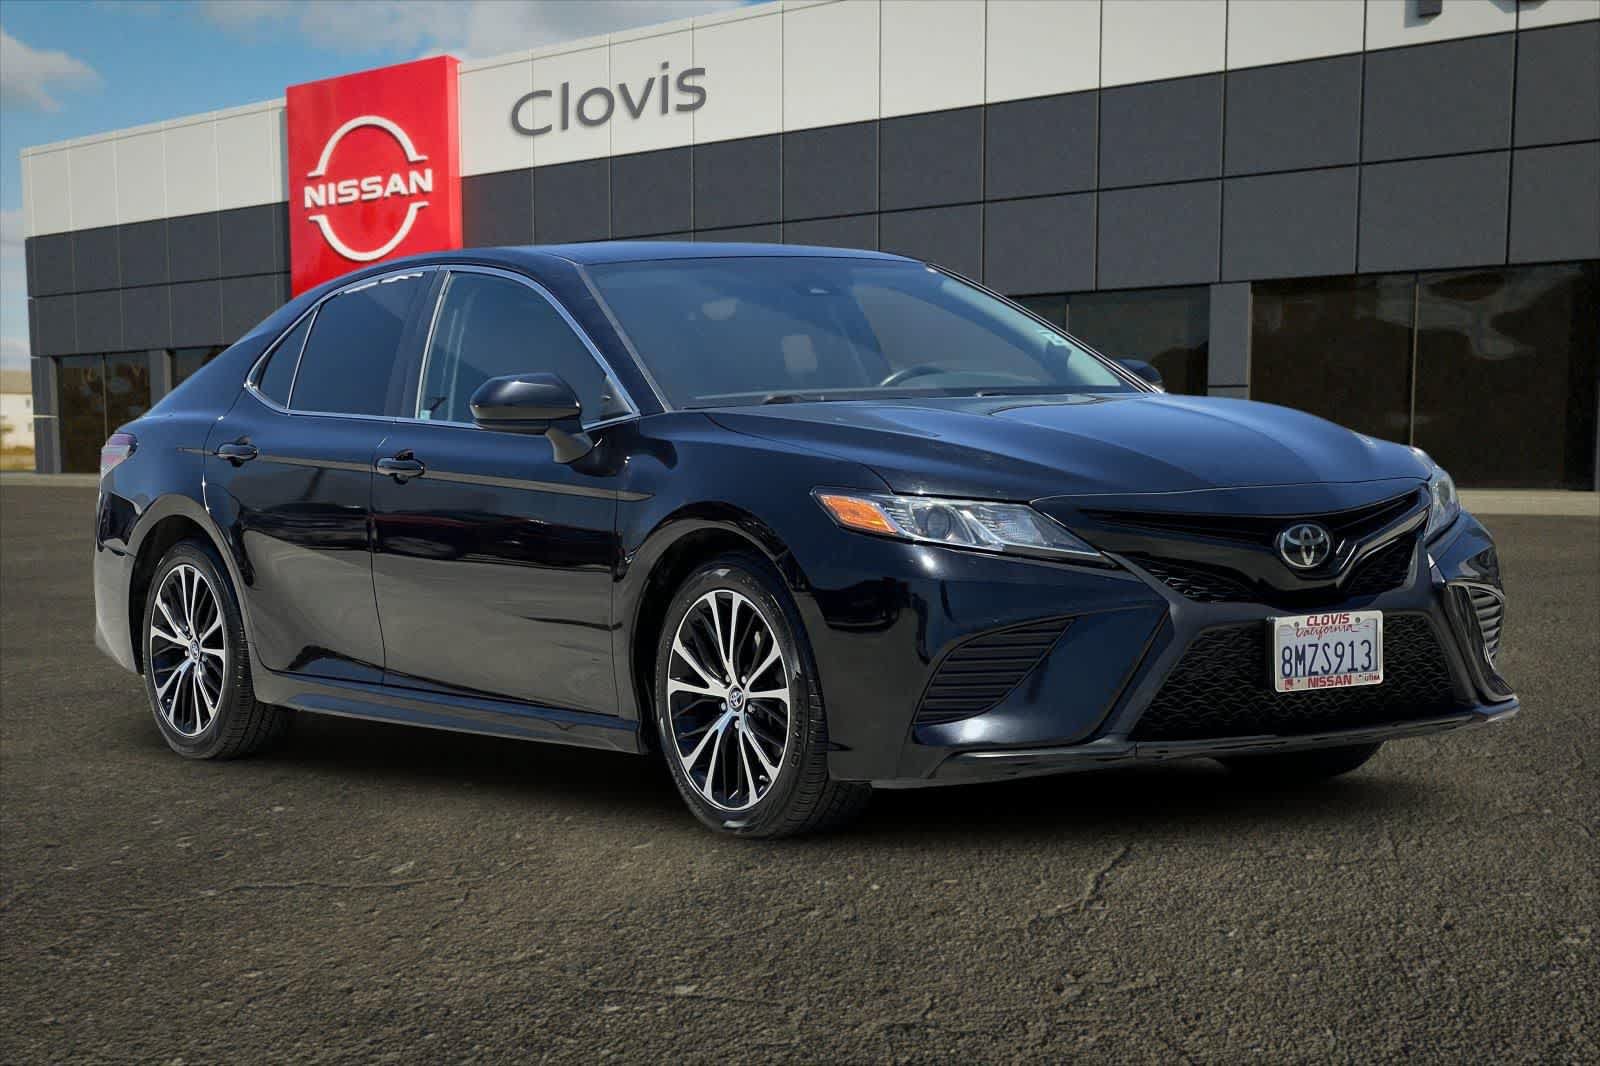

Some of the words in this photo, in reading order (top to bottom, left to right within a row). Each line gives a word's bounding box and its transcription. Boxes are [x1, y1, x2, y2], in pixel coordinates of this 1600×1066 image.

[510, 61, 708, 136] Clovis
[303, 169, 433, 209] NISSAN
[1295, 624, 1356, 640] California
[1306, 613, 1350, 626] CLOVIS
[1281, 639, 1372, 677] 8MZS913
[1307, 675, 1352, 688] NISSAN
